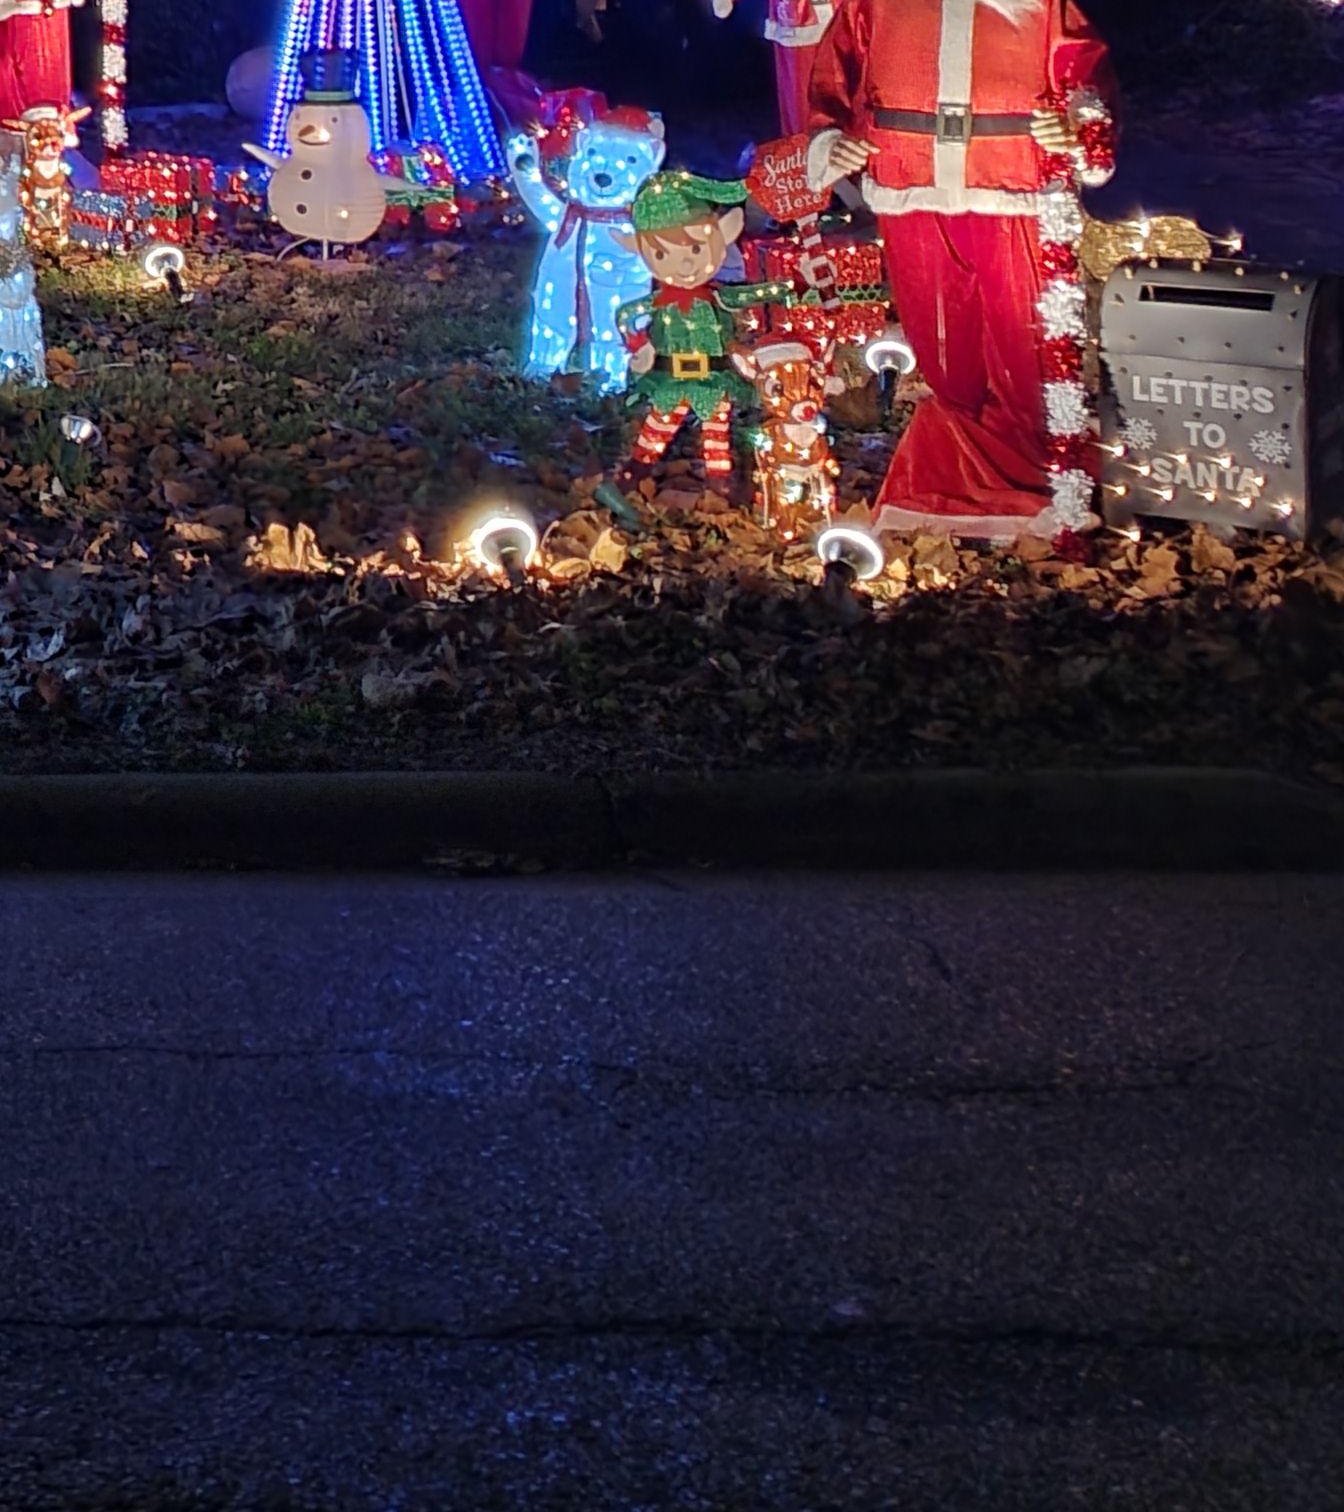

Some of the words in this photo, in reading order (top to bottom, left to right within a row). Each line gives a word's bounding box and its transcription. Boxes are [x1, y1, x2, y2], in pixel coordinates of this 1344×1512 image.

[774, 193, 822, 214] Here
[1132, 375, 1275, 414] LETTERS
[1183, 420, 1226, 449] TO
[1151, 458, 1262, 498] SANTA
